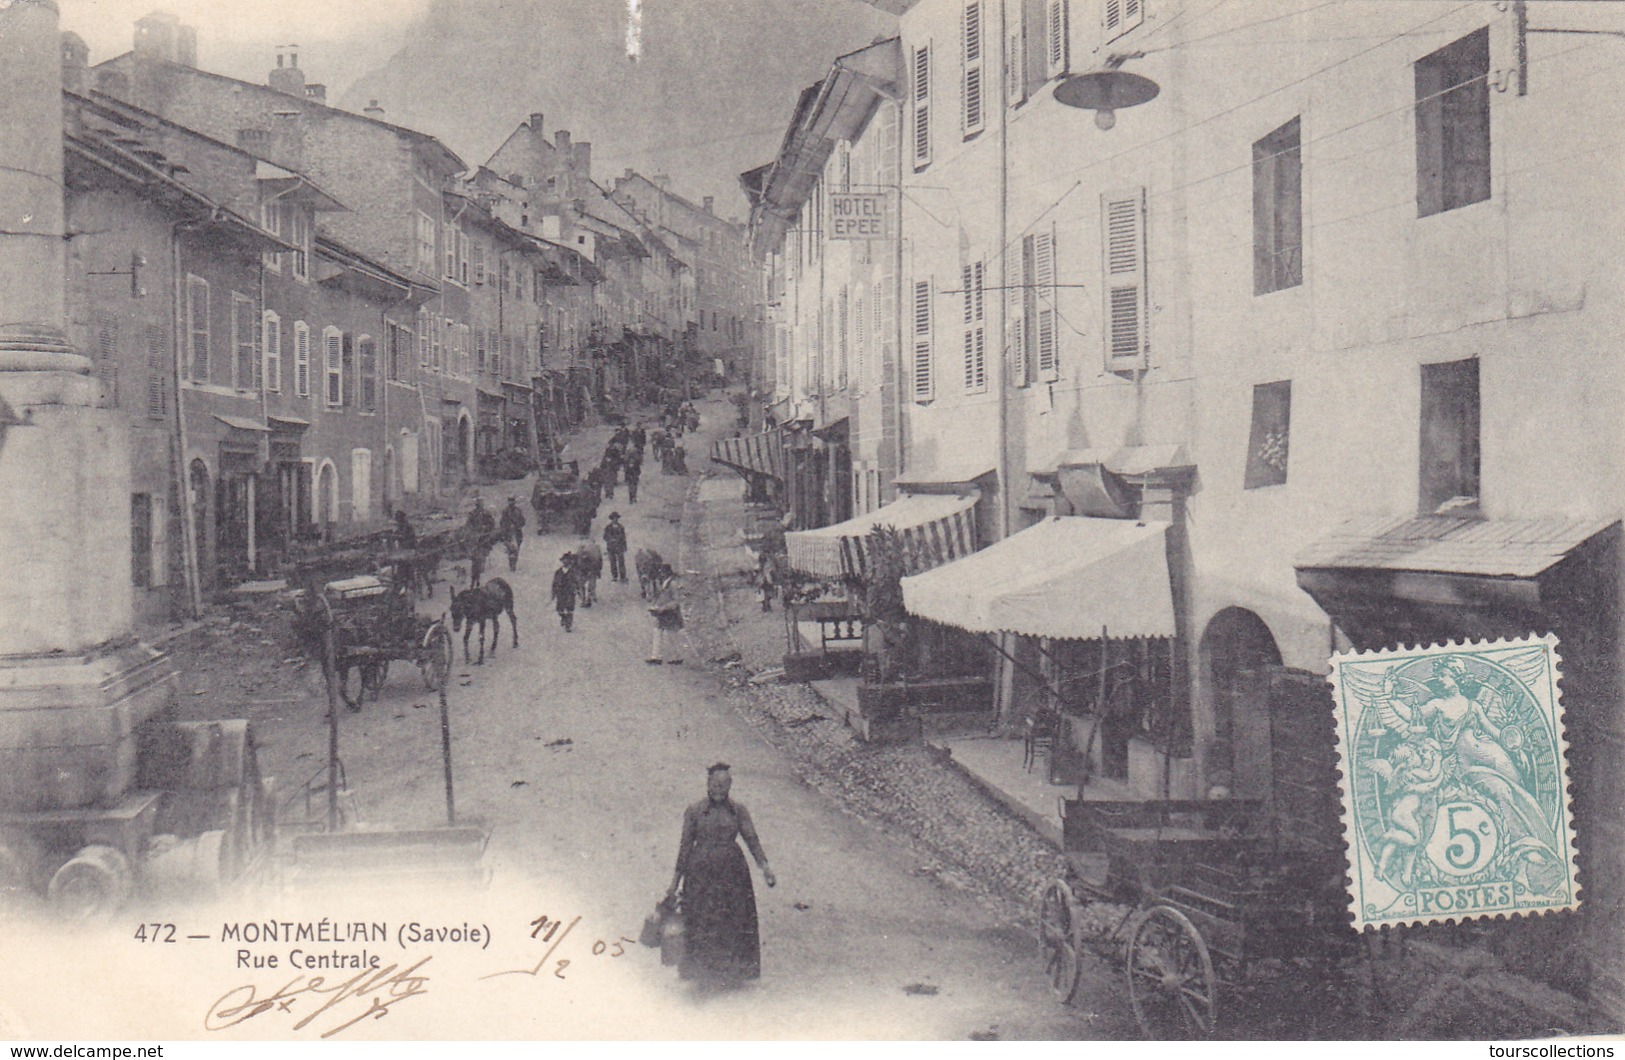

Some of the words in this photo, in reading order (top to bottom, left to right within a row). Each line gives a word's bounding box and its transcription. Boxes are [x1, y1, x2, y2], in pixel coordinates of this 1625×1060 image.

[833, 197, 882, 216] HOTEL
[834, 218, 881, 234] EPEE
[1419, 884, 1511, 913] POSTES
